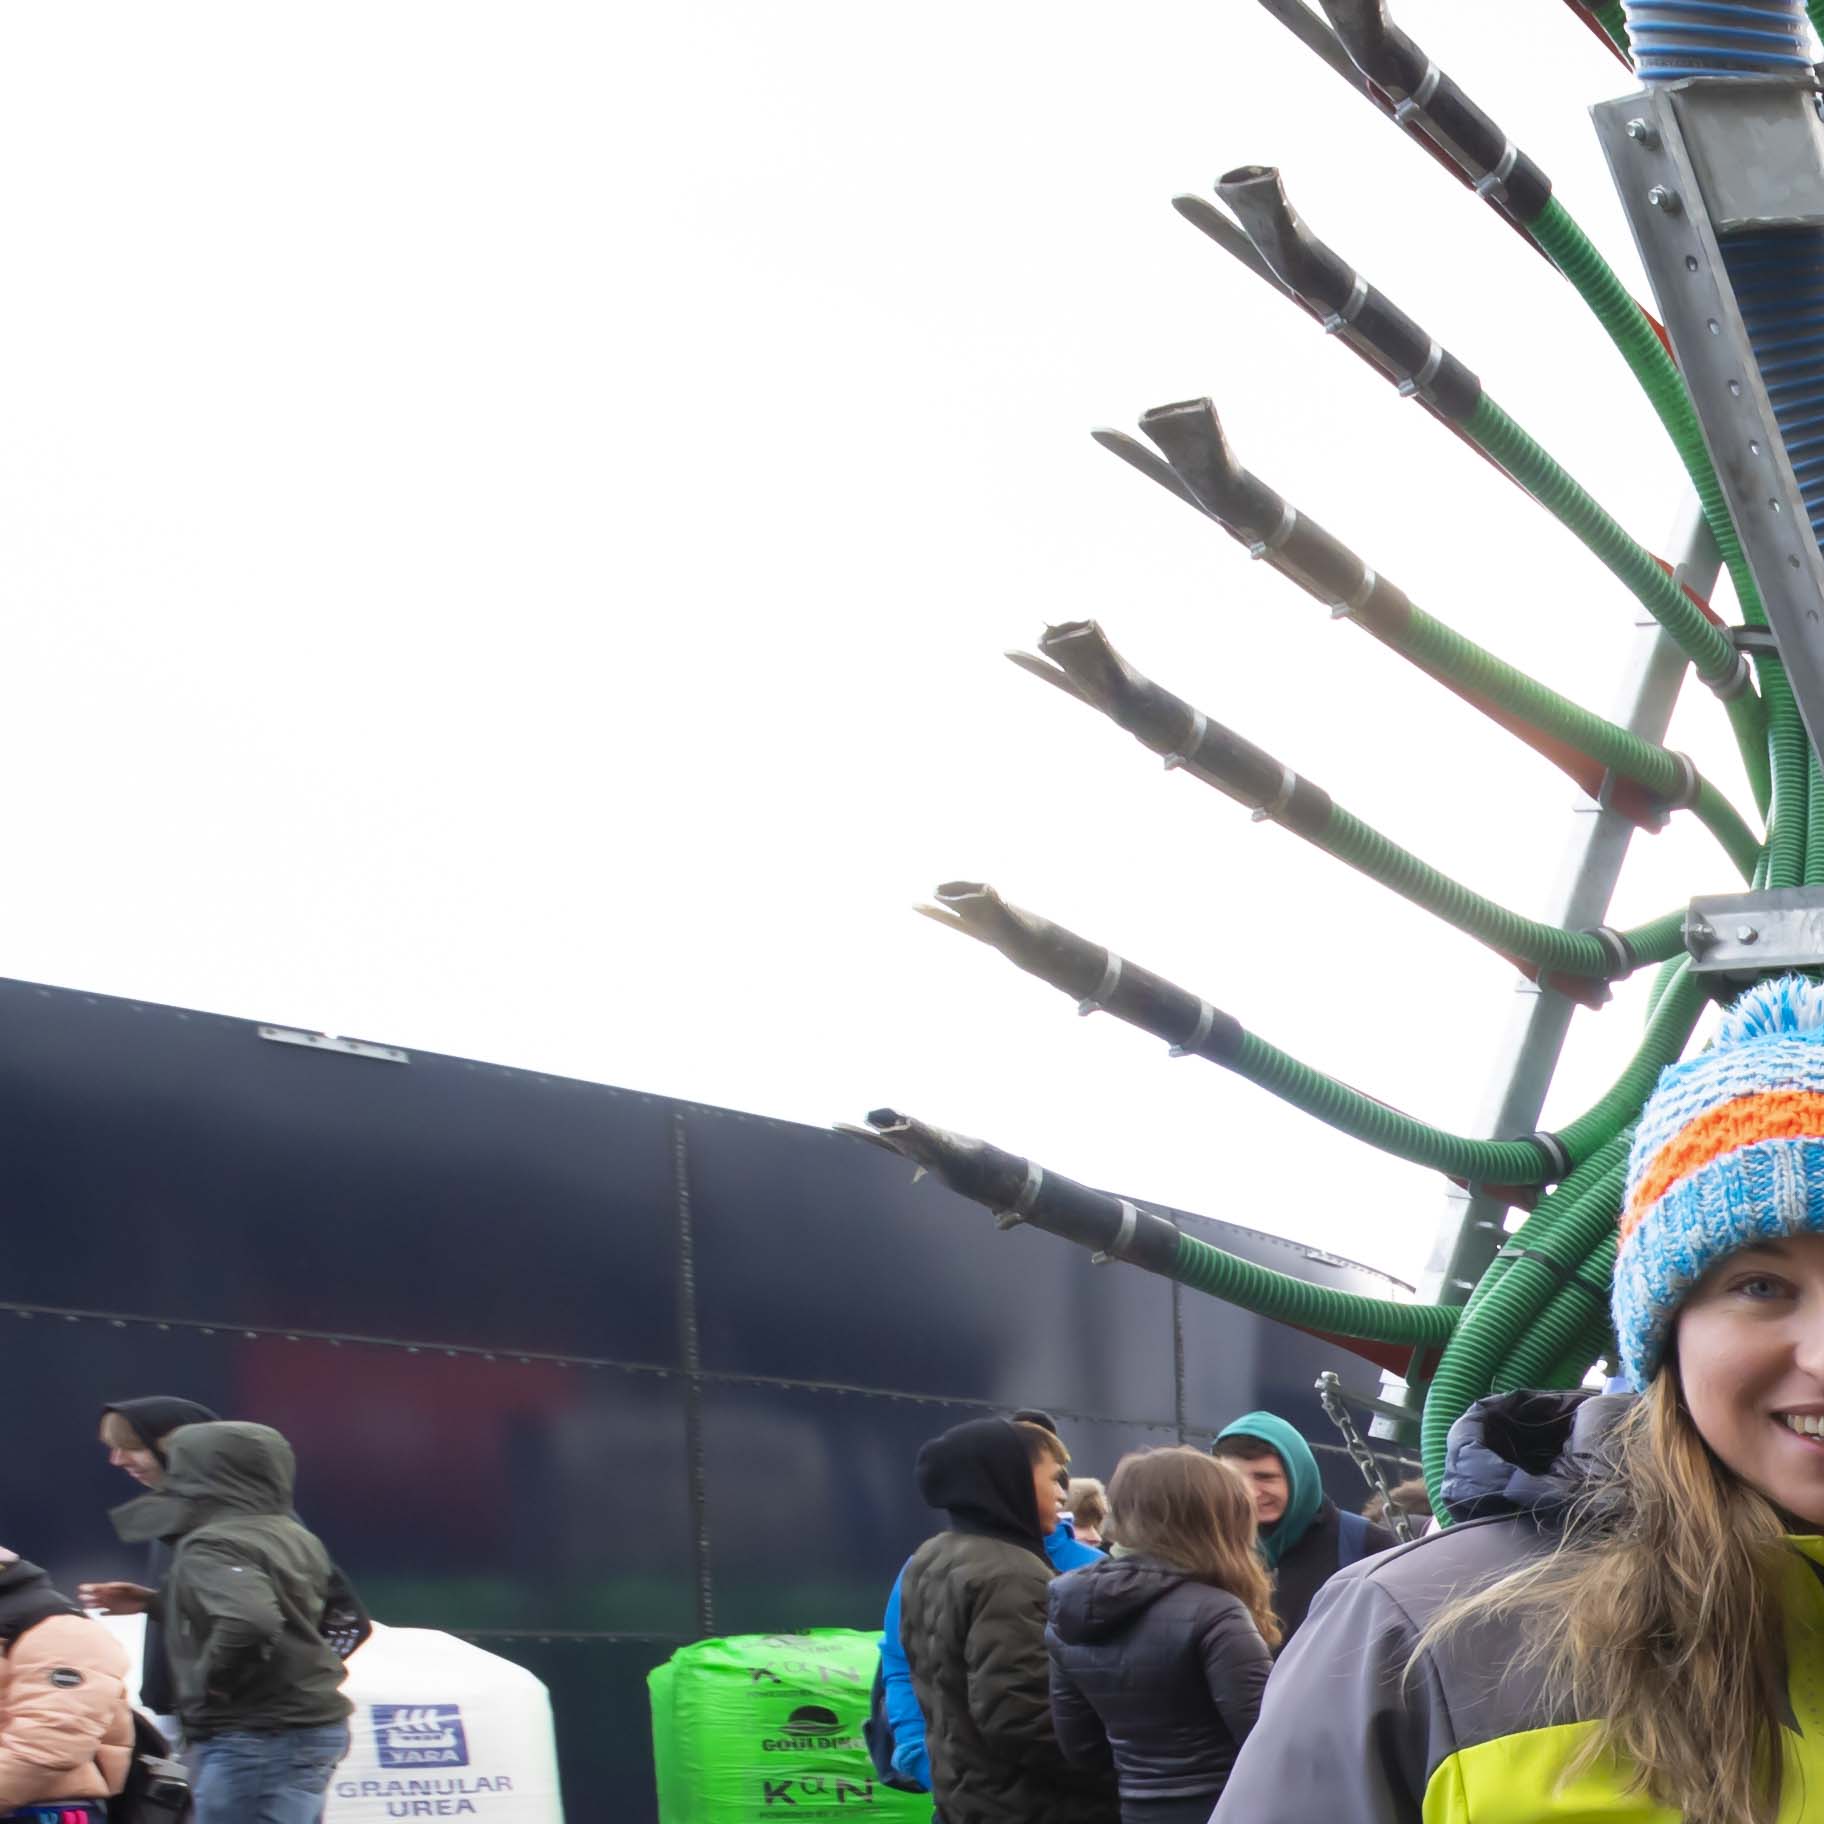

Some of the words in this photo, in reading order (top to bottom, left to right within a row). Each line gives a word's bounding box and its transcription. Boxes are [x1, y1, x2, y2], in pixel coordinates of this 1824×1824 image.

[388, 1750, 460, 1763] YARA
[335, 1776, 514, 1798] GRANULAR
[387, 1799, 477, 1817] UREA
